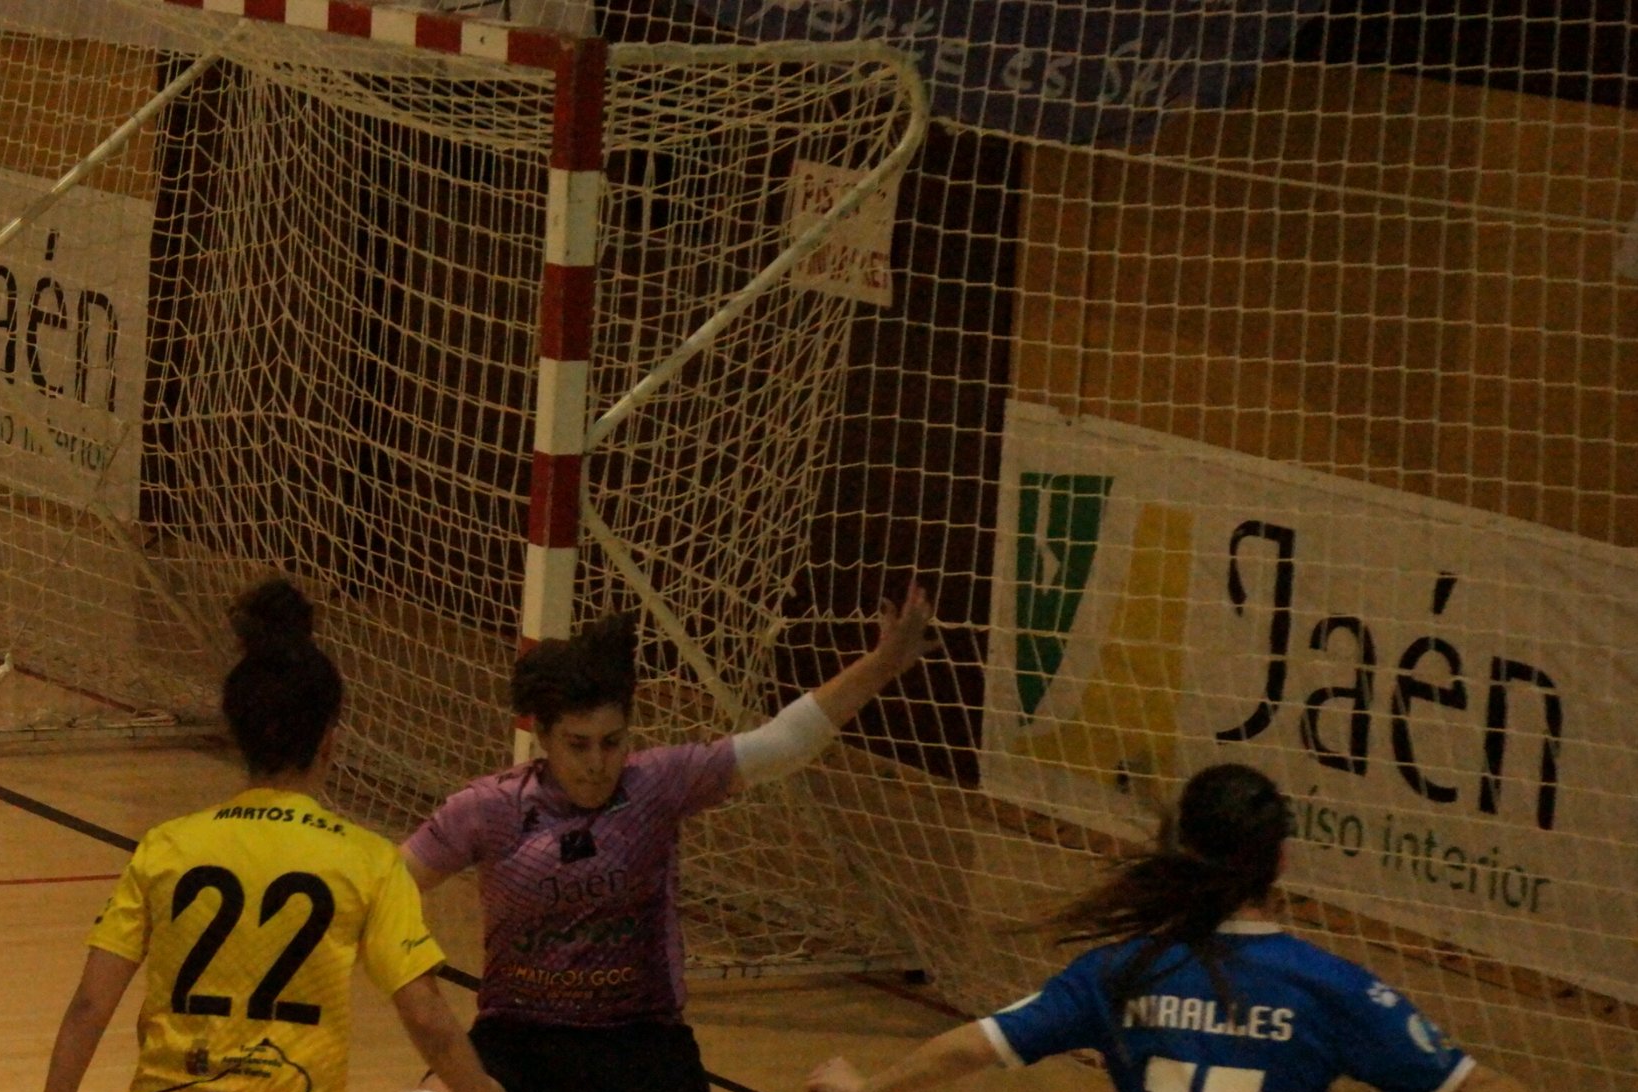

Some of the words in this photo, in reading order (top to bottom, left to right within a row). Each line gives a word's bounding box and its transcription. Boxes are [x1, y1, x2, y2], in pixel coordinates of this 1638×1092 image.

[1216, 520, 1562, 830] Jaén
[214, 806, 294, 822] MARTOS
[302, 812, 346, 836] F.S.F.
[1381, 813, 1551, 912] interior
[171, 865, 335, 1025] 22
[1122, 995, 1296, 1042] MIRALLES
